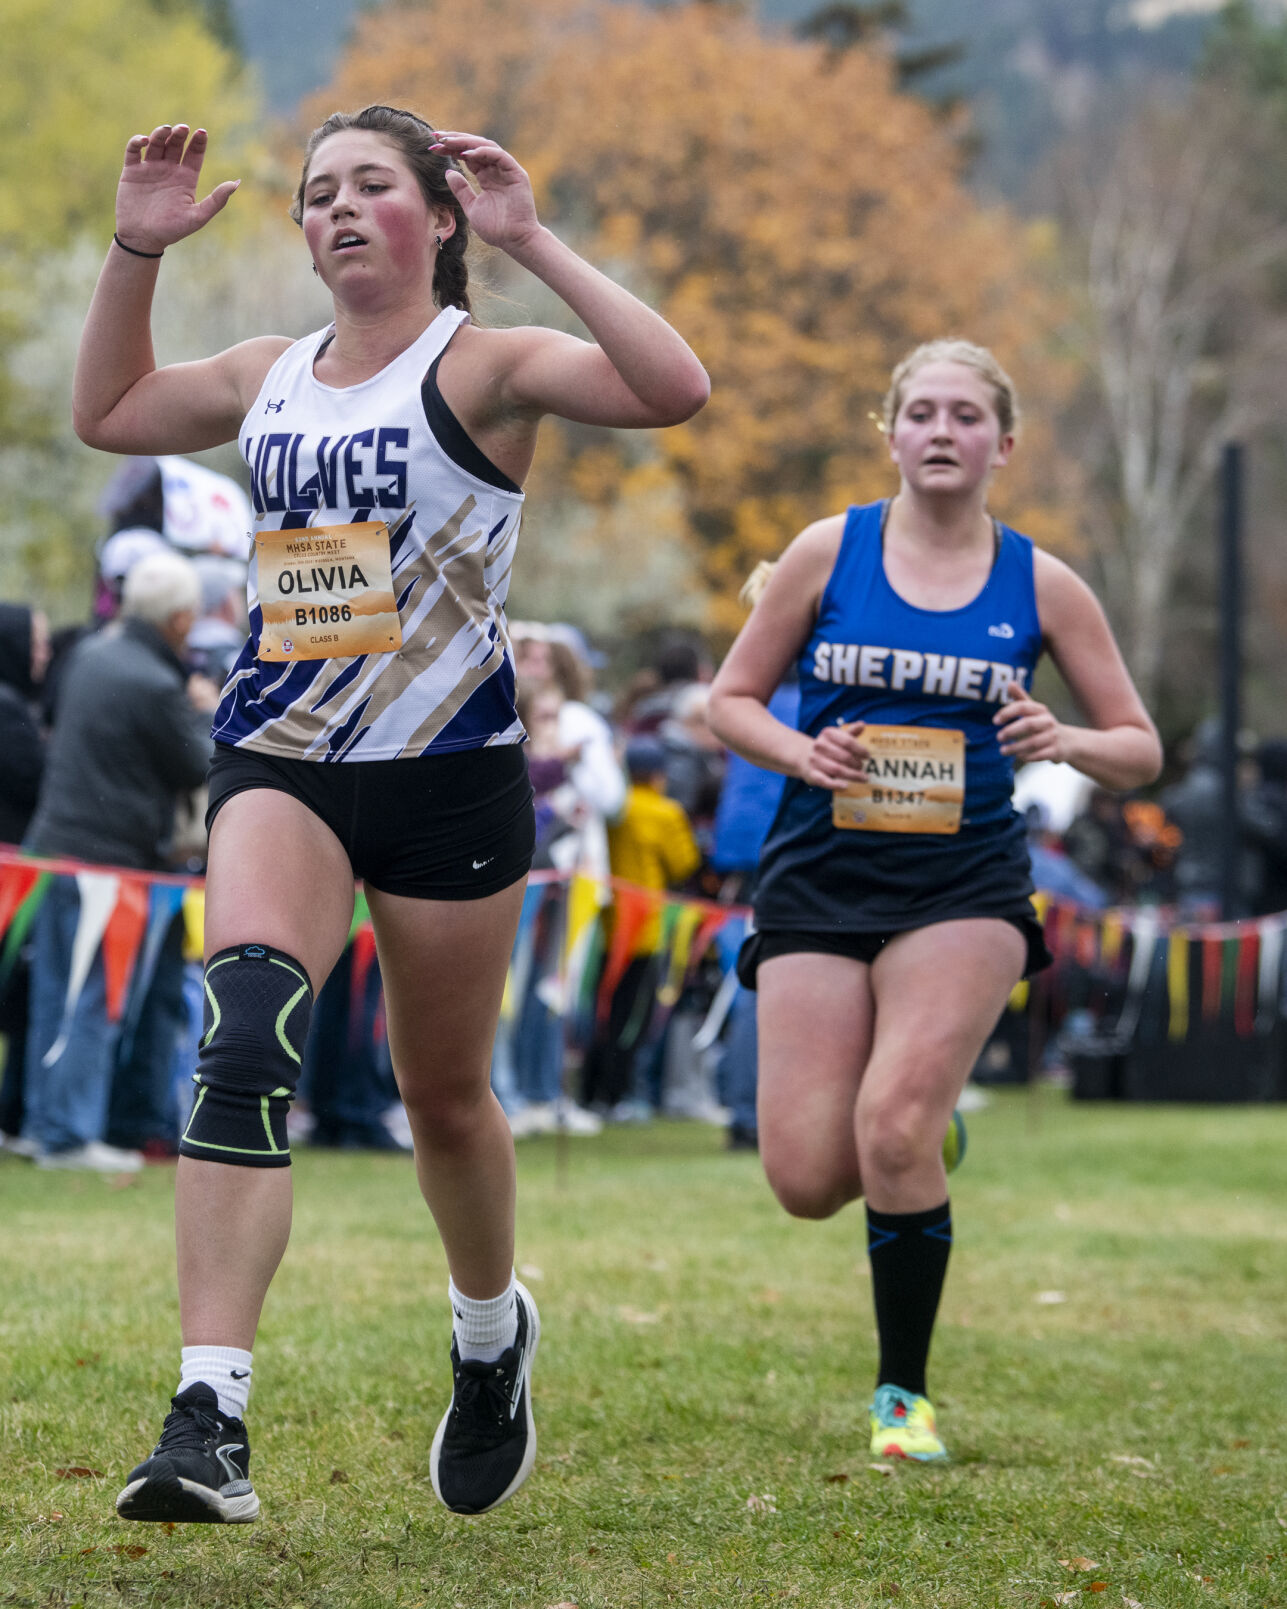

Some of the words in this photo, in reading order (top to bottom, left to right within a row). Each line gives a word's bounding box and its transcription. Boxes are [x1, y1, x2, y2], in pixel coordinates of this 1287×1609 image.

[286, 541, 313, 553] MHSA
[315, 539, 347, 551] STATE
[278, 564, 369, 595] OLIVIA
[295, 604, 352, 626] B1086
[310, 634, 332, 644] CLASS
[333, 634, 339, 642] B
[865, 757, 955, 781] ANNAH
[872, 788, 925, 806] B1347
